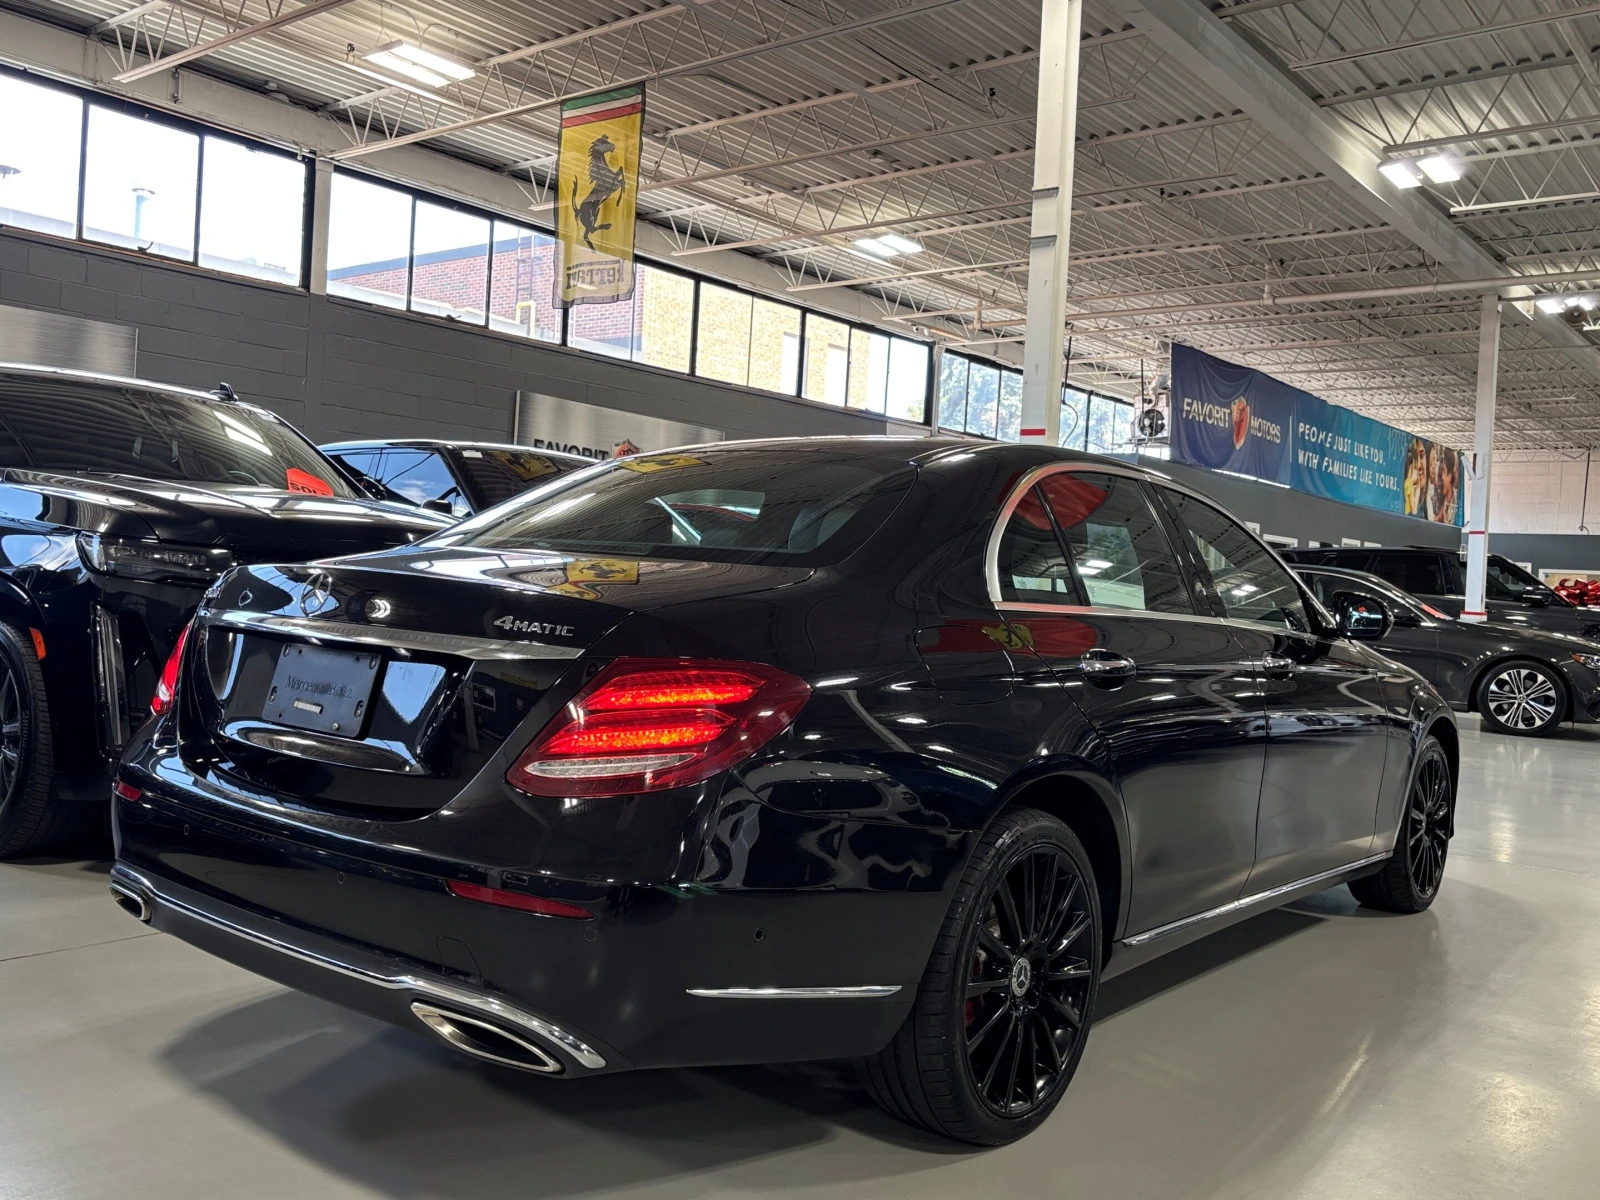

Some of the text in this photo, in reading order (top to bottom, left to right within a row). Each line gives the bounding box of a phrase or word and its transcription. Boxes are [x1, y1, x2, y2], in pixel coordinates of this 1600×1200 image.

[1183, 397, 1281, 444] FAVORIT MOTORS
[1333, 435, 1352, 454] JUST
[1354, 441, 1370, 460] LIKE
[1298, 448, 1400, 492] WITH FAMILIES LIKE YOURS.
[290, 482, 328, 496] SO
[493, 615, 575, 637] 4MATIC
